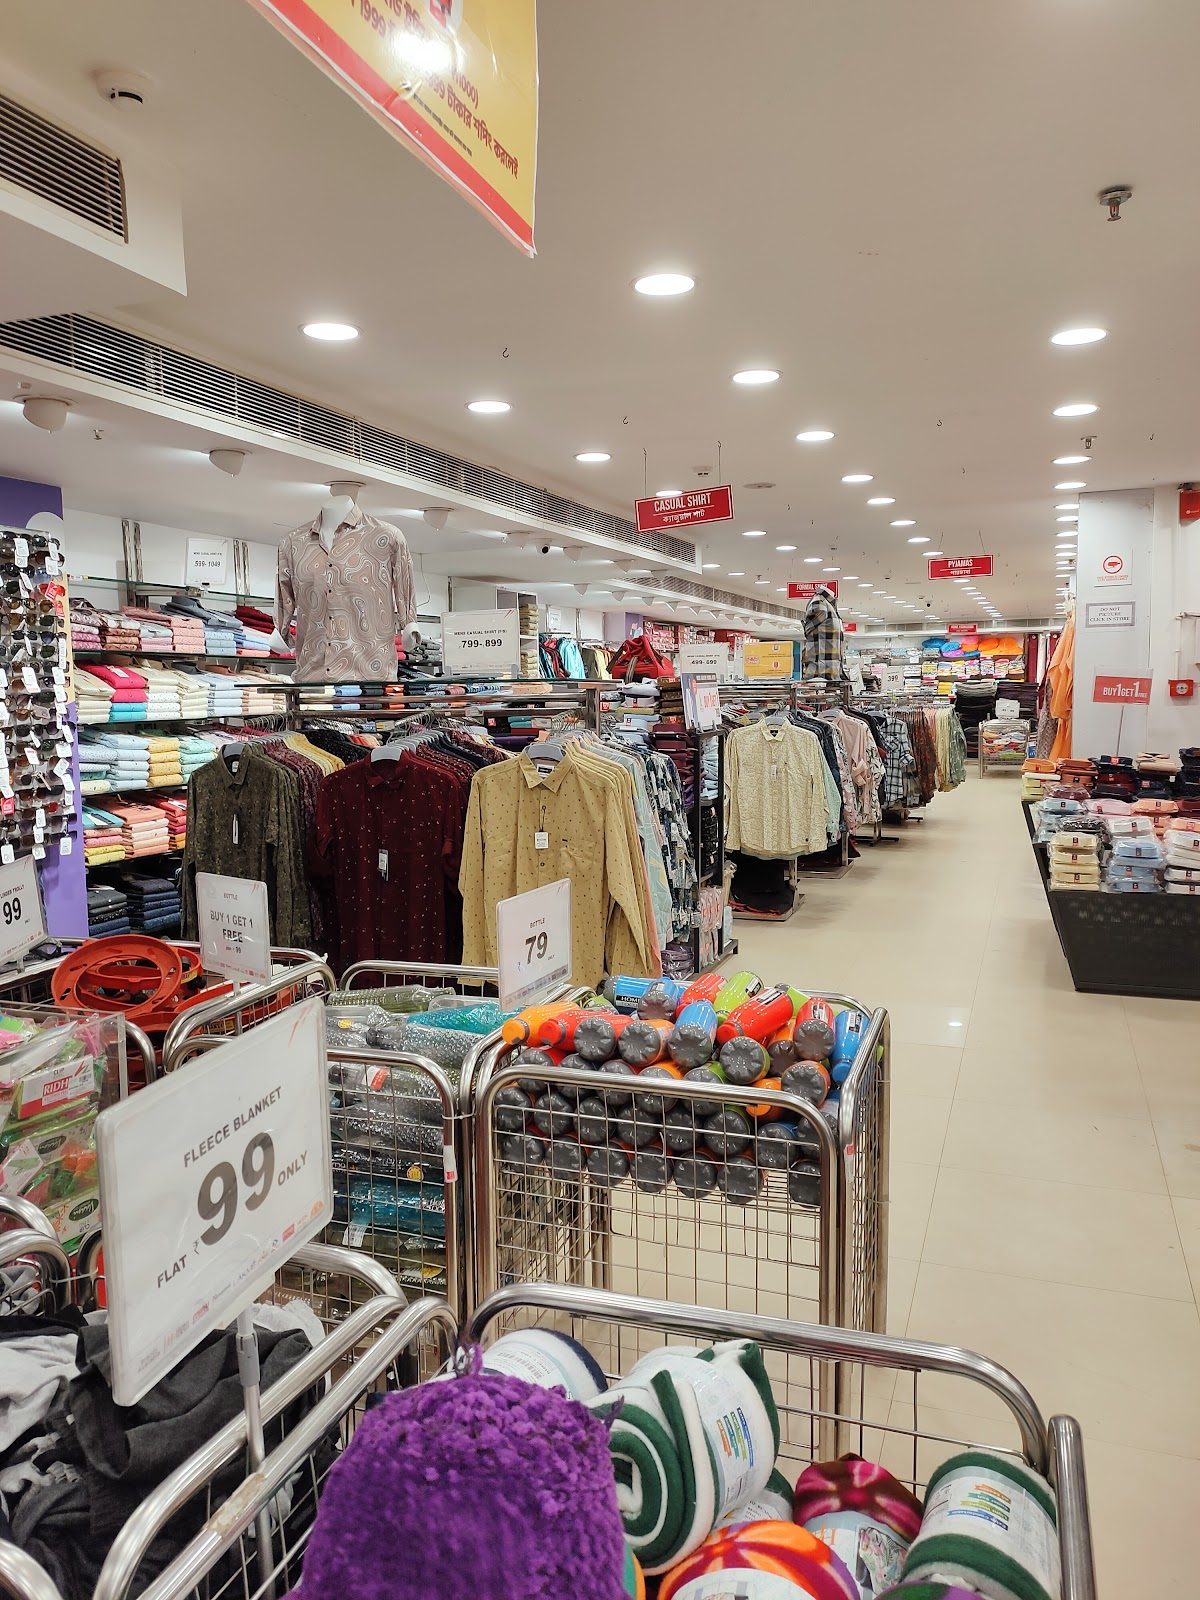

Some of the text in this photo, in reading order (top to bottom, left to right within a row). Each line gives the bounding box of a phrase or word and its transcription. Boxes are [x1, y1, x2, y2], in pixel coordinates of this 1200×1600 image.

[654, 492, 712, 512] CASUAL SHIRT
[947, 558, 974, 568] PYJAMAS
[223, 892, 238, 900] BOTTLE
[210, 910, 253, 928] BUY 1 GET 1
[529, 917, 546, 929] BOTTLE
[222, 928, 244, 943] FREE
[183, 1086, 282, 1168] FLEECE BLANKET
[157, 1254, 188, 1289] FLAT
[197, 1132, 276, 1246] 99
[277, 1149, 308, 1187] ONLY
